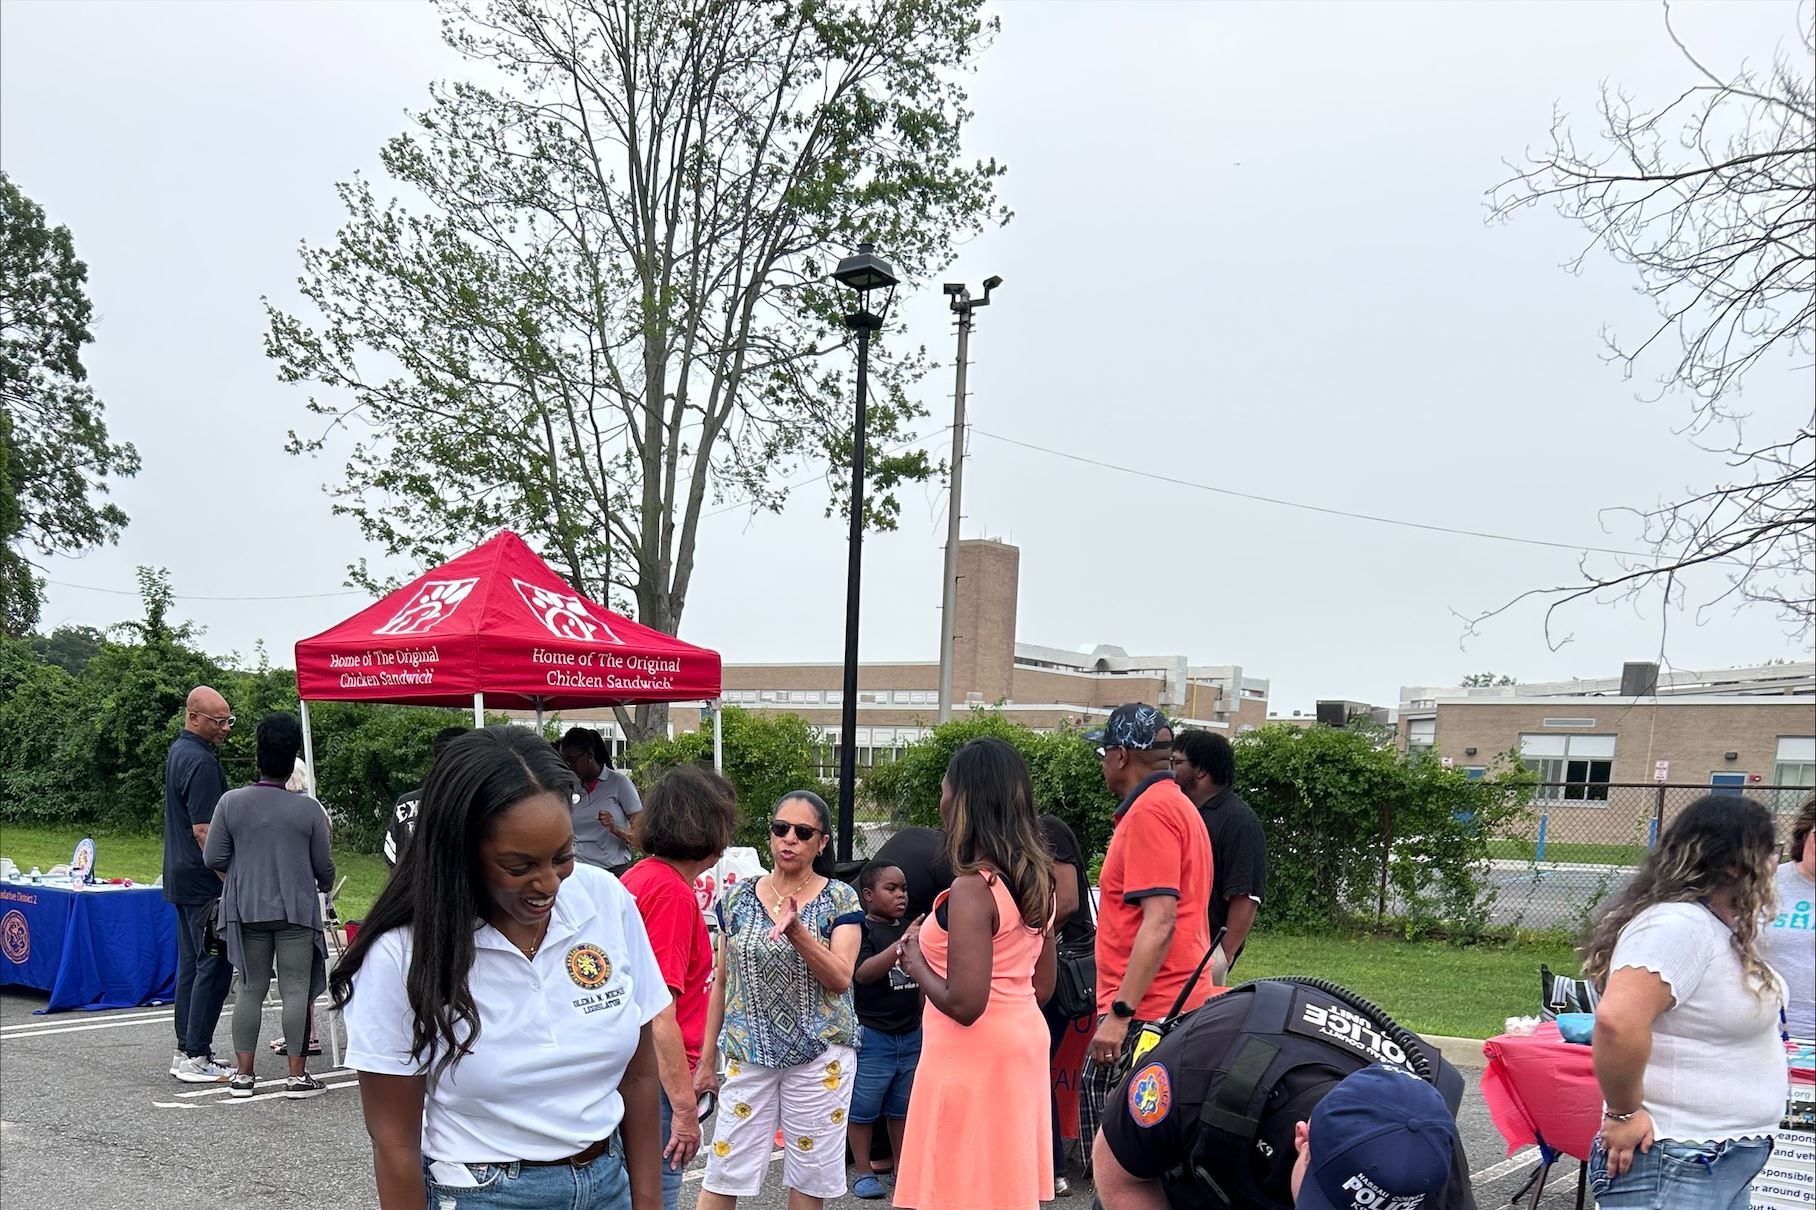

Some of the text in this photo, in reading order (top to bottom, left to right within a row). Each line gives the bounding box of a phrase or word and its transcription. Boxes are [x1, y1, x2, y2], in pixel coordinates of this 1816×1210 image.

[330, 646, 439, 668] Home of The Original
[532, 648, 680, 675] Home of The Original
[339, 671, 380, 688] Chicken
[546, 670, 603, 688] Chicken
[583, 998, 621, 1014] LEGISLATOR
[1327, 1005, 1371, 1030] UNIT
[1319, 1026, 1365, 1050] COUNTY
[1256, 1139, 1273, 1157] K9
[1773, 1149, 1794, 1158] and
[1357, 1172, 1426, 1201] NASSAU COUNTY
[1762, 1185, 1800, 1197] around
